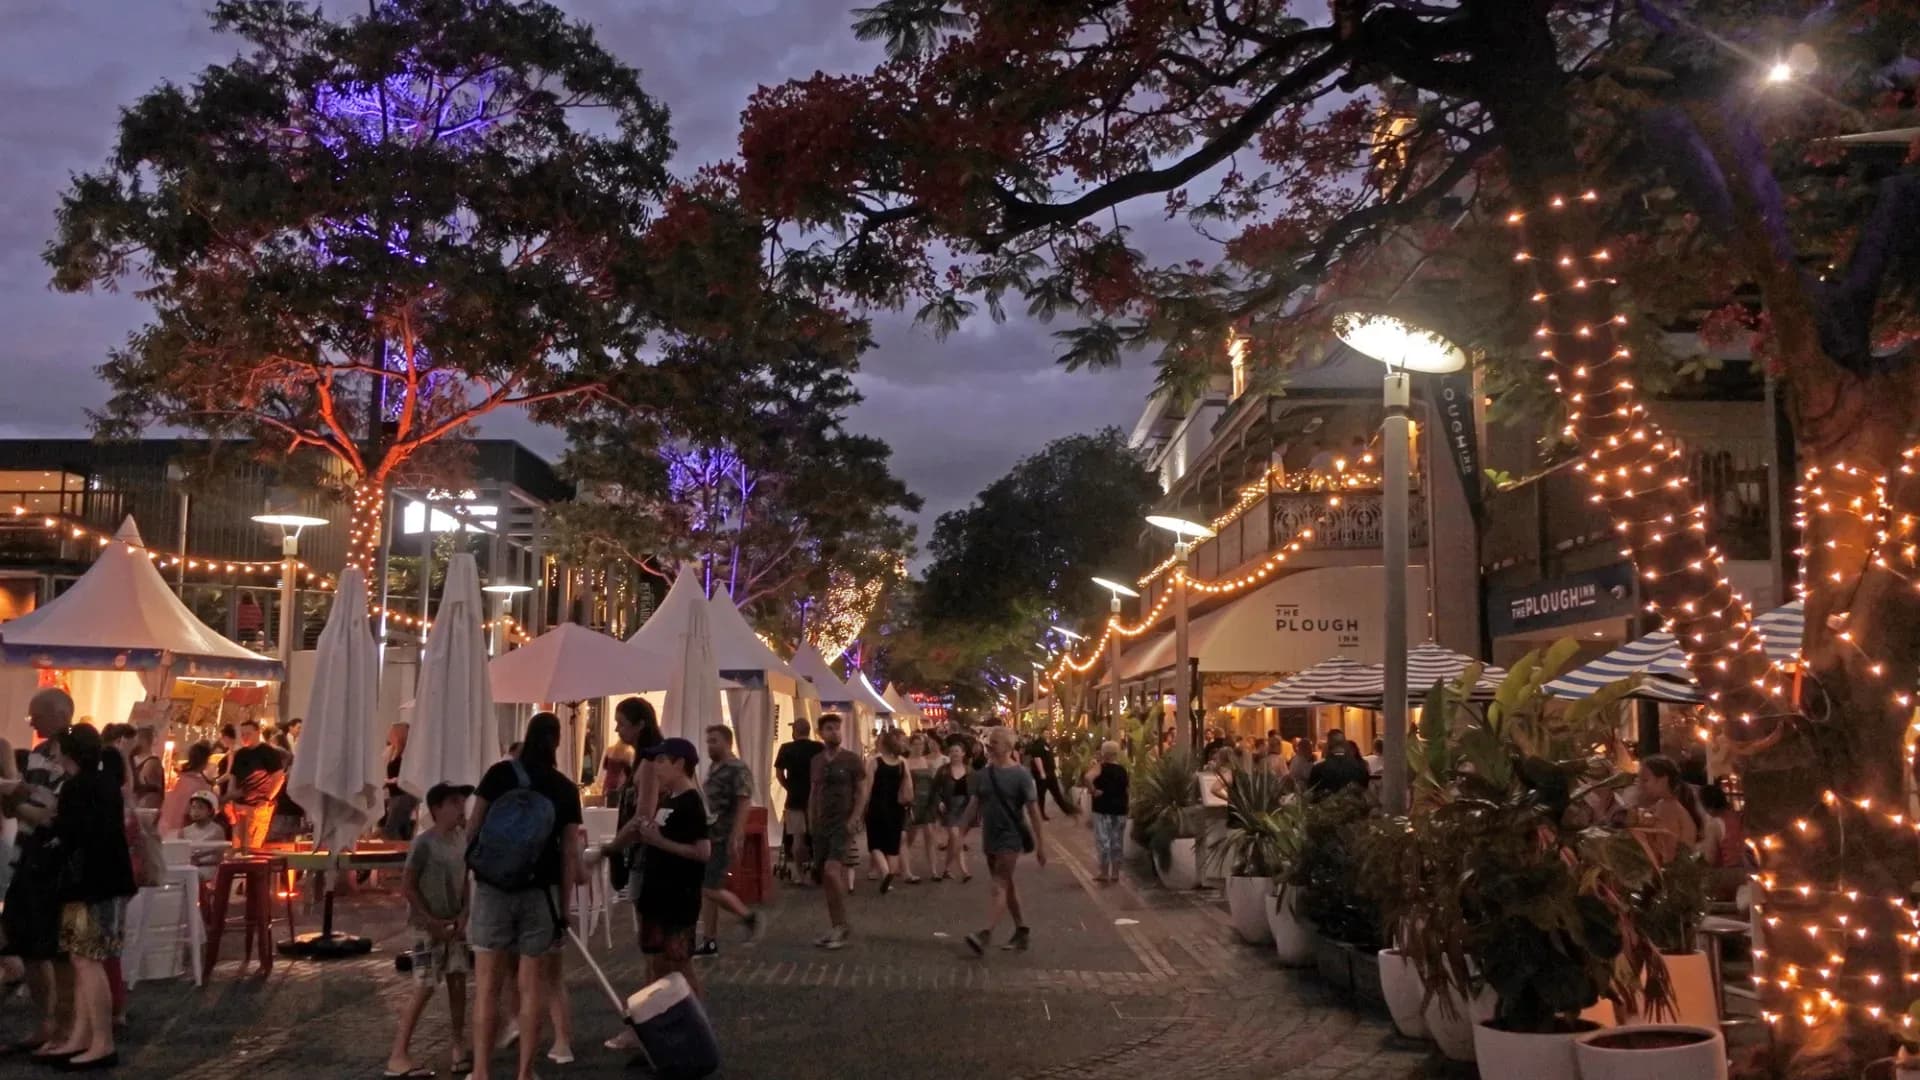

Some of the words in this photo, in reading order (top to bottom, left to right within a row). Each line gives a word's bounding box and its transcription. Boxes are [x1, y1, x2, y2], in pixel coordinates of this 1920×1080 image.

[1440, 374, 1467, 449] LOUGH
[1511, 606, 1526, 619] THE
[1525, 587, 1579, 617] PLOUGH
[1579, 584, 1595, 599] INN
[1275, 608, 1299, 617] THE
[1276, 619, 1359, 632] PLOUGH
[1338, 634, 1359, 643] INN
